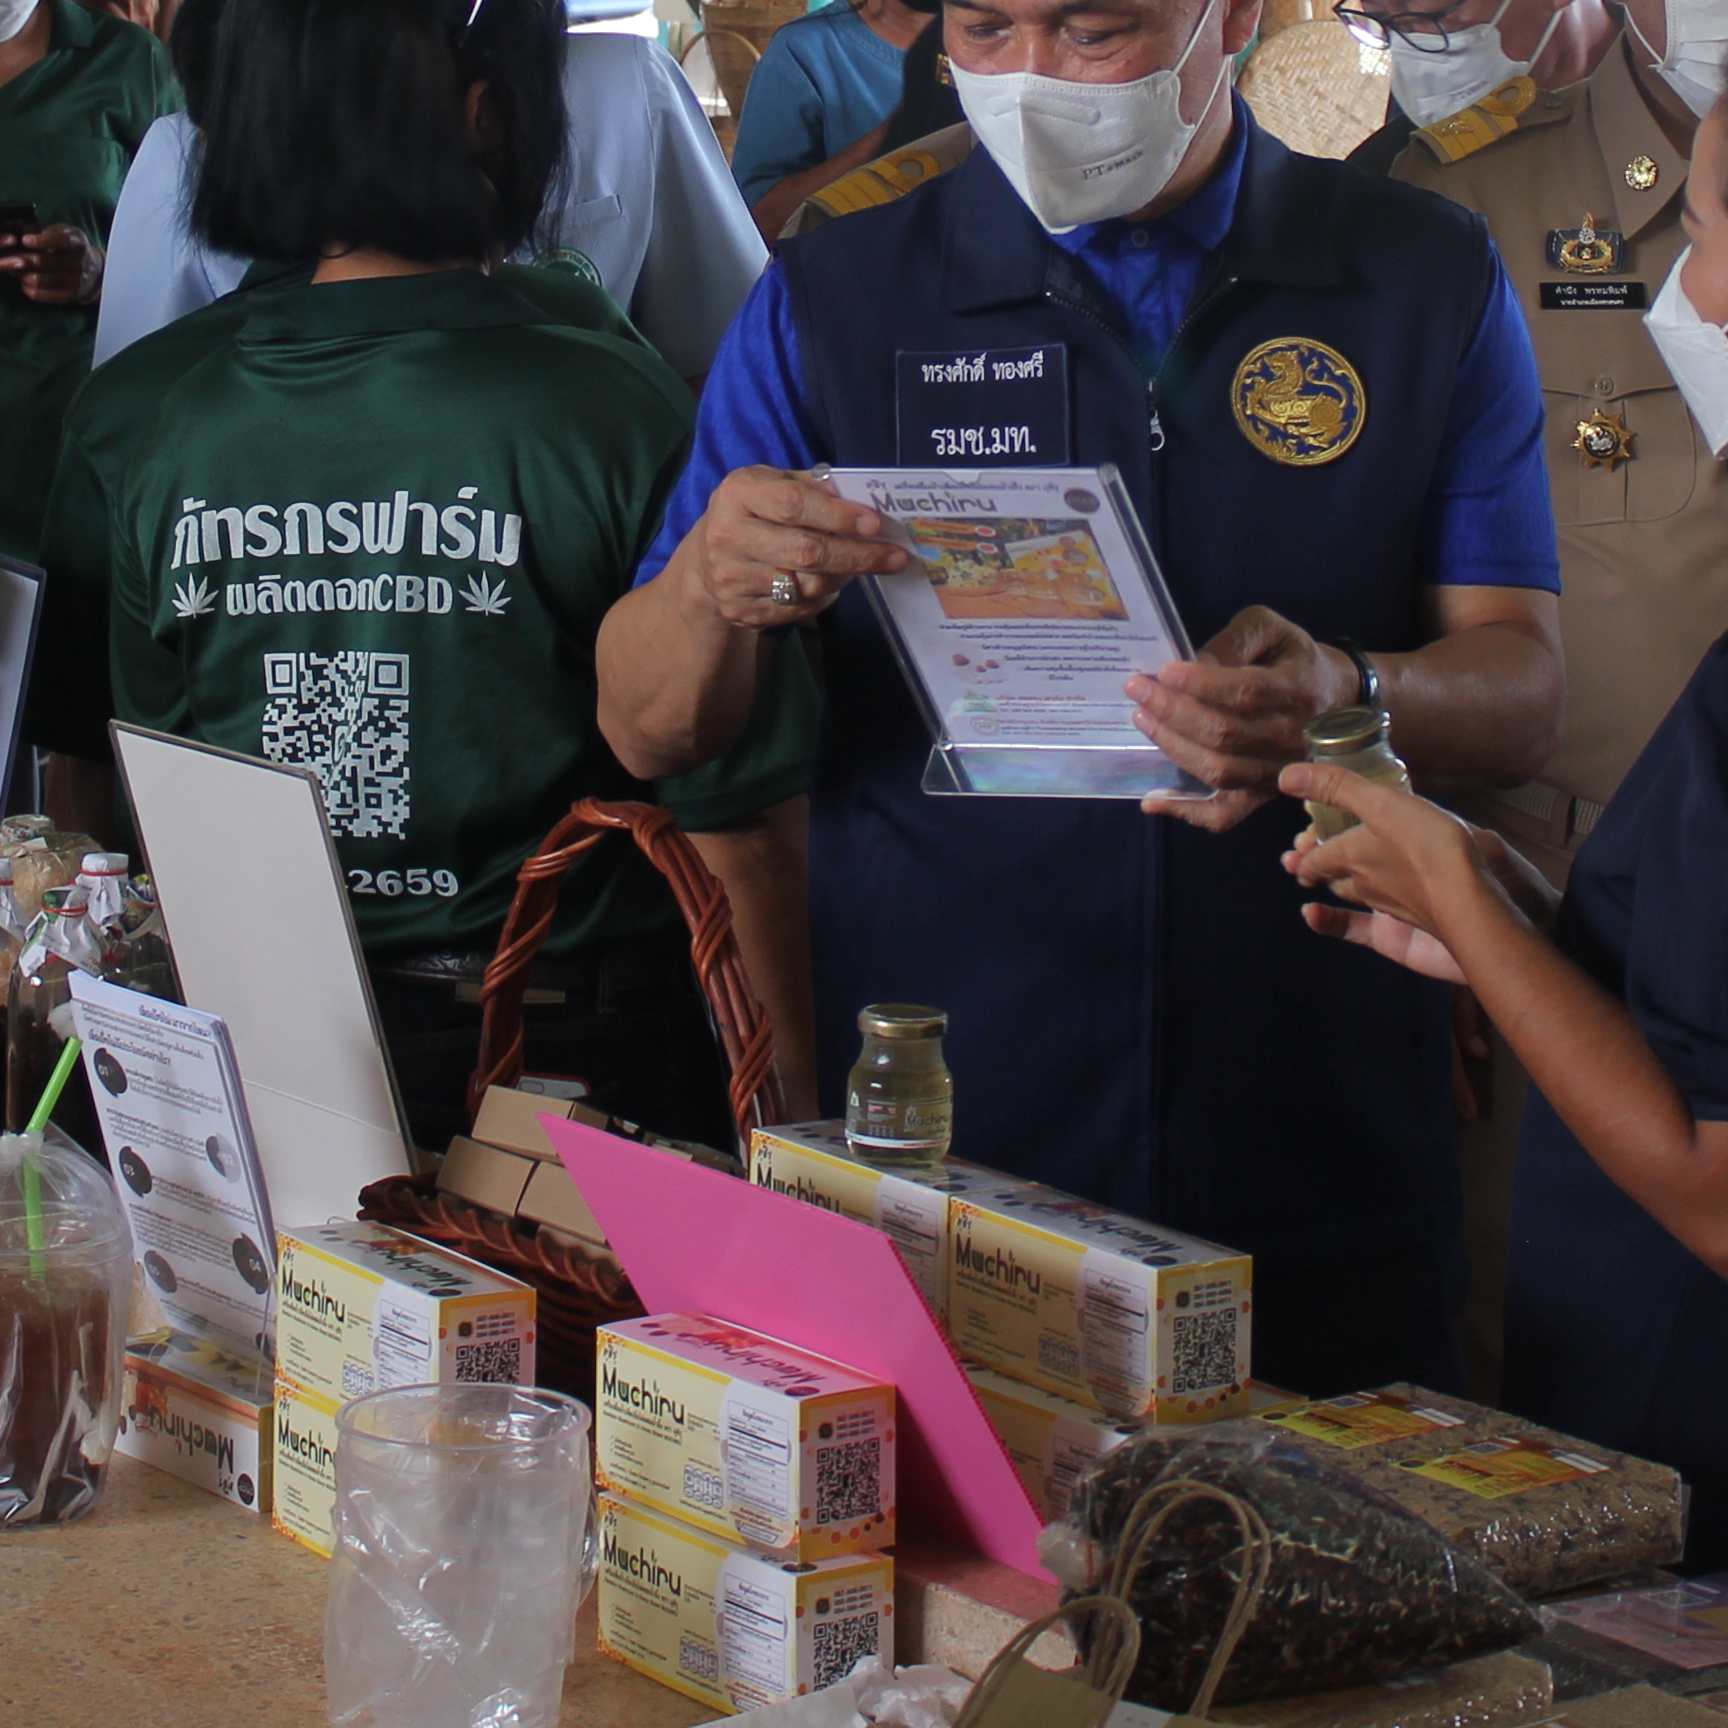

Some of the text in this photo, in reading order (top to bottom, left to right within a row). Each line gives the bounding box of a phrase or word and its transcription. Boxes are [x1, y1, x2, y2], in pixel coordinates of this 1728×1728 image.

[921, 350, 1044, 383] ทรงศักดิ์ ทองศรี
[930, 426, 1037, 456] รมช.มท.
[869, 490, 999, 514] Muchiru
[955, 1233, 1041, 1294] Muchiru
[281, 1264, 346, 1323] Muchiru
[602, 1365, 685, 1424] Muchiru
[603, 1533, 681, 1597] Muchiru
